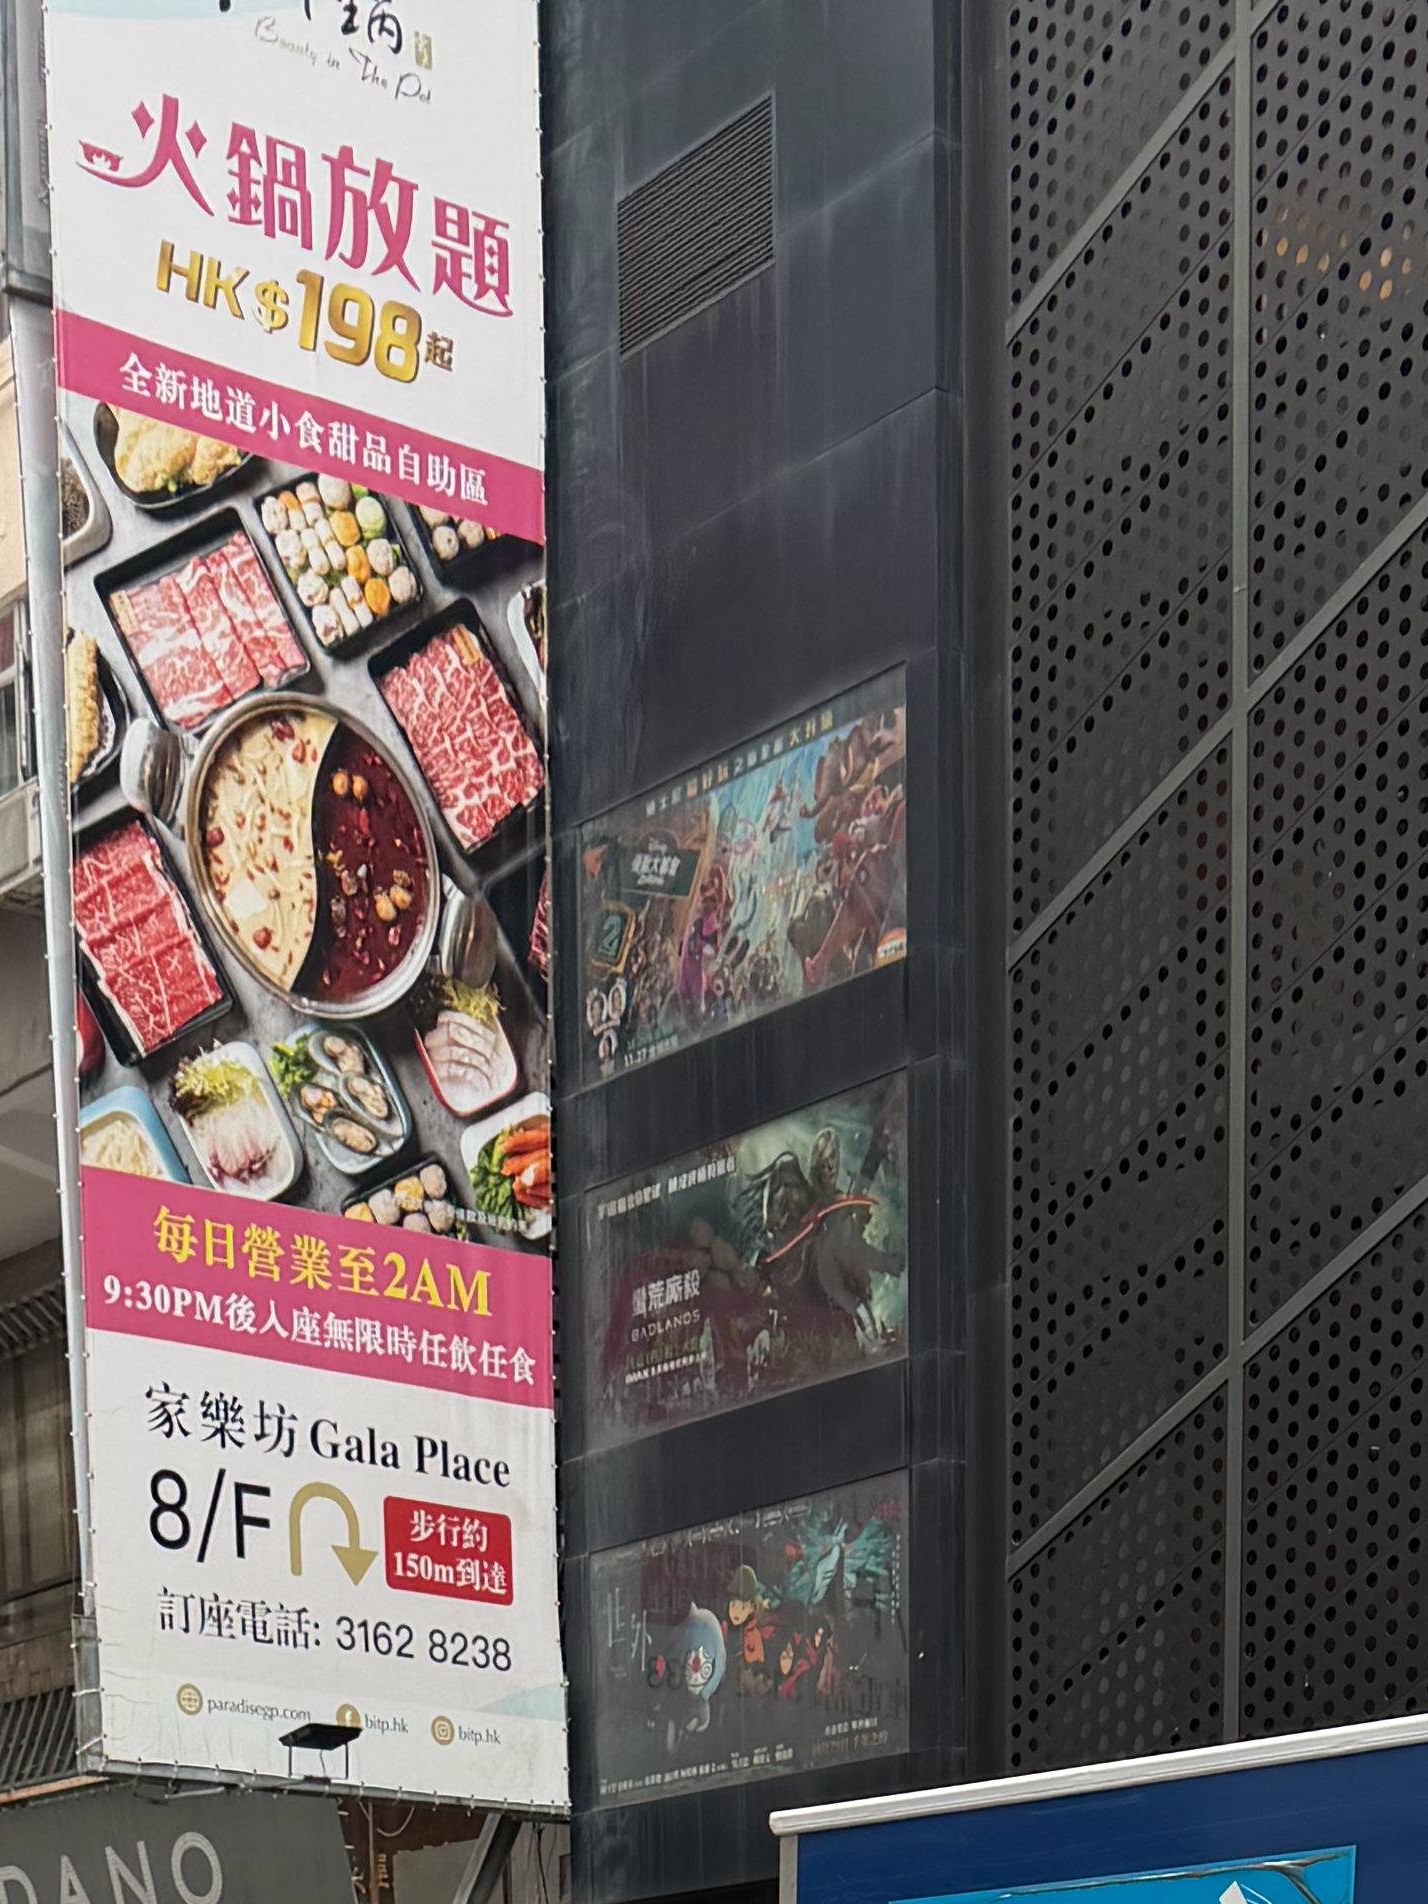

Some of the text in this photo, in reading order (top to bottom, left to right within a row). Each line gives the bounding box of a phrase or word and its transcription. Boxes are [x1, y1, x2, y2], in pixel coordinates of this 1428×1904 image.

[76, 93, 514, 317] 火鍋放題
[119, 352, 489, 506] 全新地道小食甜品自助區
[154, 1204, 492, 1317] 每日營業至2AM
[102, 1275, 537, 1385] 9:30PM後入座無限時任飲任食
[144, 1381, 512, 1488] 家樂坊 Gala Place
[148, 1467, 273, 1563] 8/F
[409, 1508, 489, 1553] 步行約
[392, 1550, 508, 1596] 150m到達
[156, 1585, 513, 1673] 訂座電話: 3162 8238
[206, 1696, 312, 1722] paradisegp.com
[363, 1711, 410, 1736] bitp.hk
[457, 1723, 502, 1747] bitp.hk
